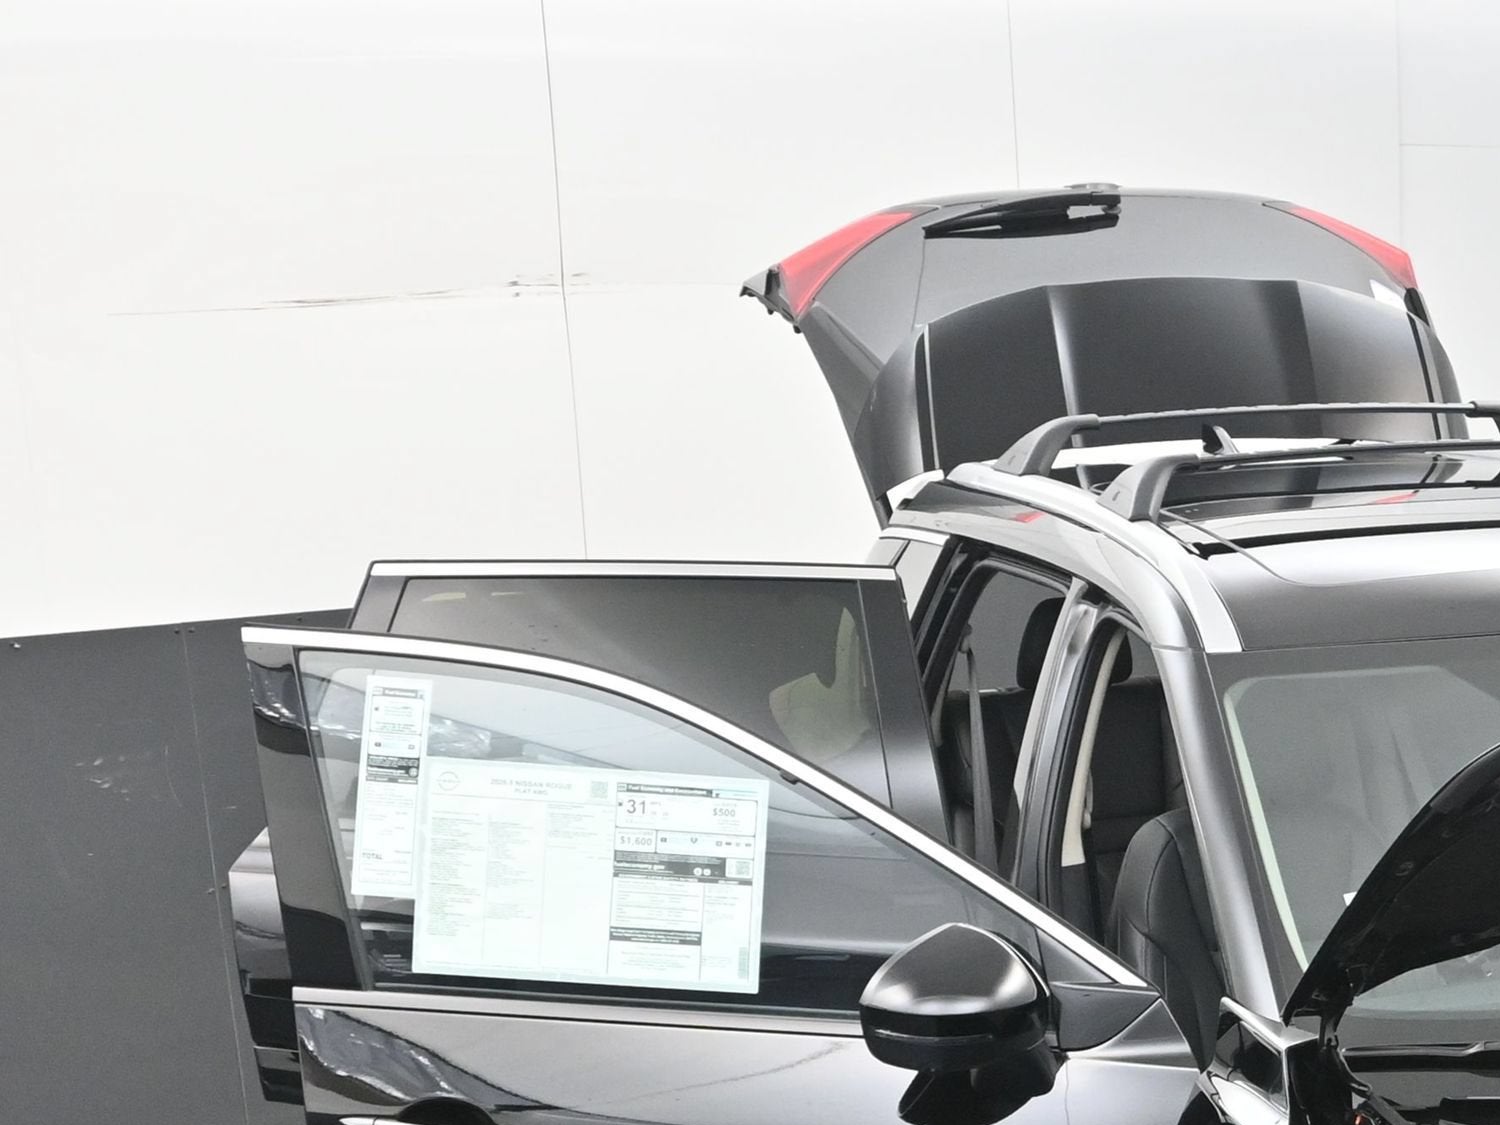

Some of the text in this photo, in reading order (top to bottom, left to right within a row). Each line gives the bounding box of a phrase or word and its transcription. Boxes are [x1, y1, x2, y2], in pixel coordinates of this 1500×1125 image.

[626, 799, 646, 815] 31
[712, 807, 736, 817] $500
[619, 835, 652, 846] $1,600
